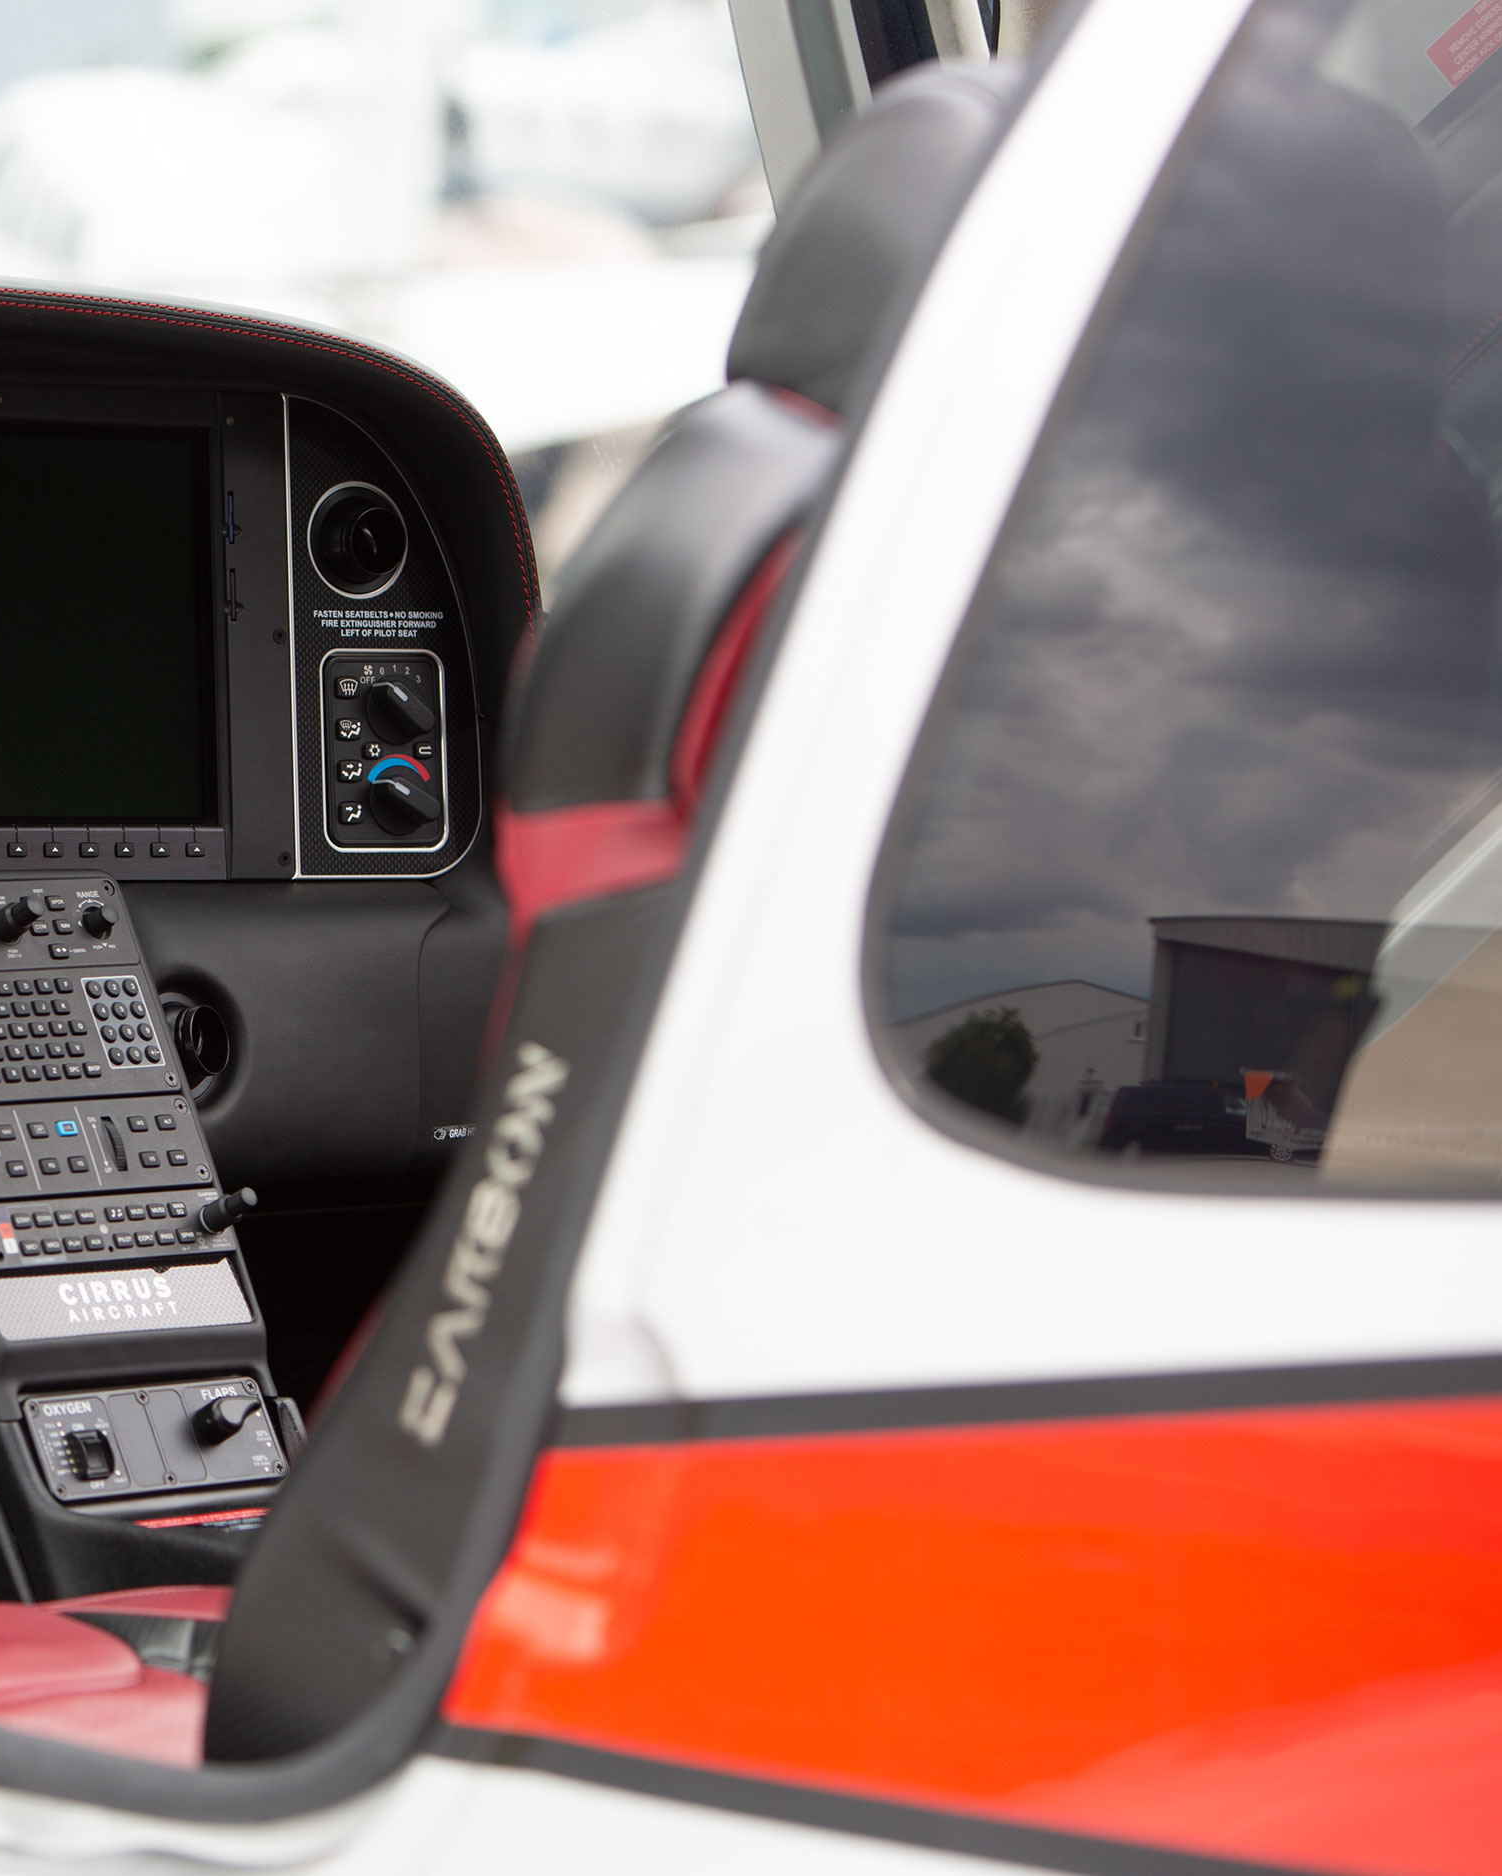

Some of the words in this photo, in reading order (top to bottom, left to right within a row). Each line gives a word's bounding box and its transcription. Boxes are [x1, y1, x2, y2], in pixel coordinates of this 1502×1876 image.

[313, 610, 343, 619] FASTEN
[345, 610, 388, 619] SEATBELTS
[394, 611, 406, 619] NO
[408, 611, 443, 619] SMOKING
[321, 619, 339, 628] FIRE
[340, 619, 397, 628] EXTINGUISHER
[398, 620, 437, 629] FORWARD
[341, 629, 360, 637] LEFT
[361, 629, 372, 637] OF
[374, 629, 396, 638] PILOT
[398, 629, 417, 638] SEAT
[379, 666, 385, 675] 0
[392, 664, 397, 672] 1
[404, 667, 410, 675] 2
[360, 676, 376, 684] OFF
[415, 675, 421, 683] 3
[76, 891, 100, 899] RANGE
[59, 1276, 172, 1305] CIRRUS
[68, 1301, 177, 1323] AIRCRAFT
[200, 1386, 238, 1400] FLAPS
[43, 1400, 92, 1416] OXYGEN
[71, 1423, 85, 1431] ON
